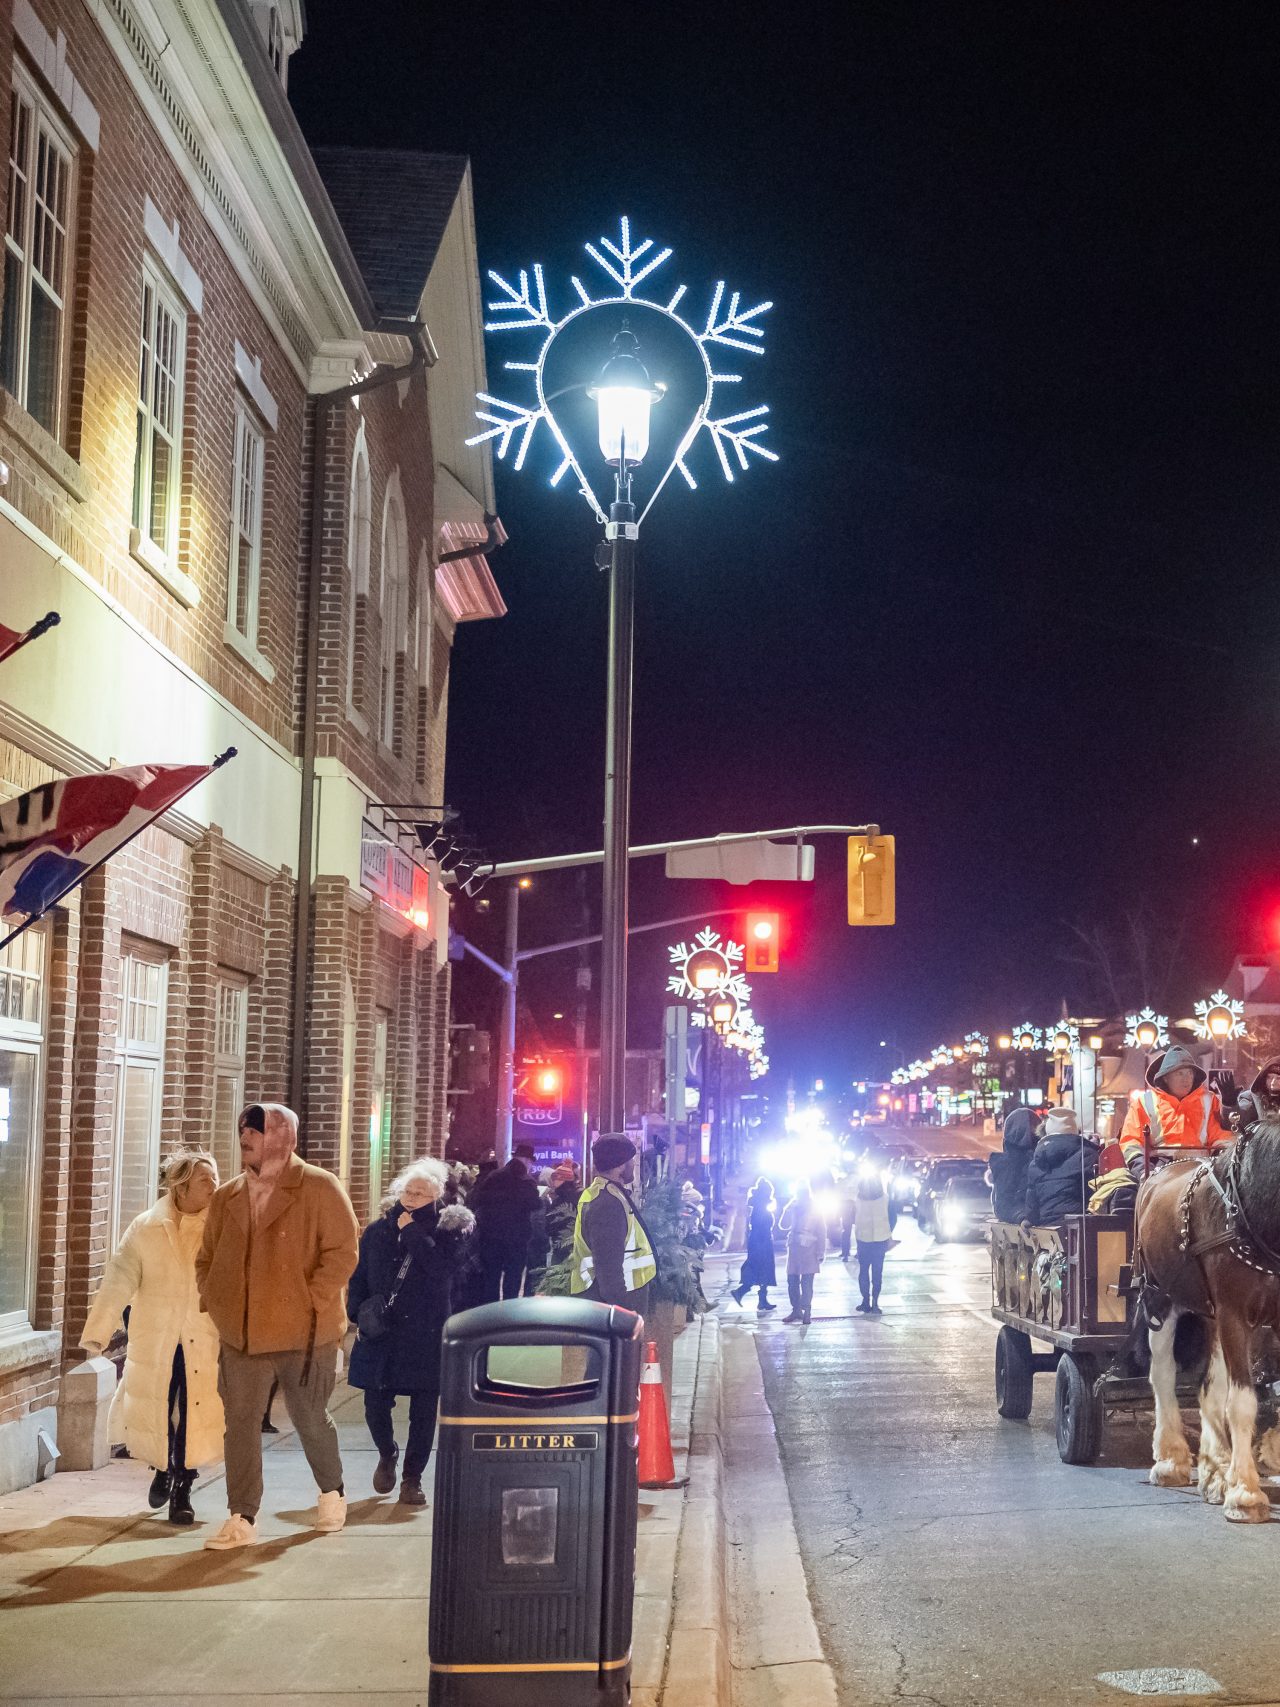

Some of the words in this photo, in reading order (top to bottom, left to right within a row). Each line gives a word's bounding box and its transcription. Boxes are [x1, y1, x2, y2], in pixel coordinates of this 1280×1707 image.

[523, 1109, 557, 1121] RBC
[533, 1150, 548, 1160] yal
[551, 1150, 574, 1160] Bank
[495, 1435, 576, 1449] LITTER
